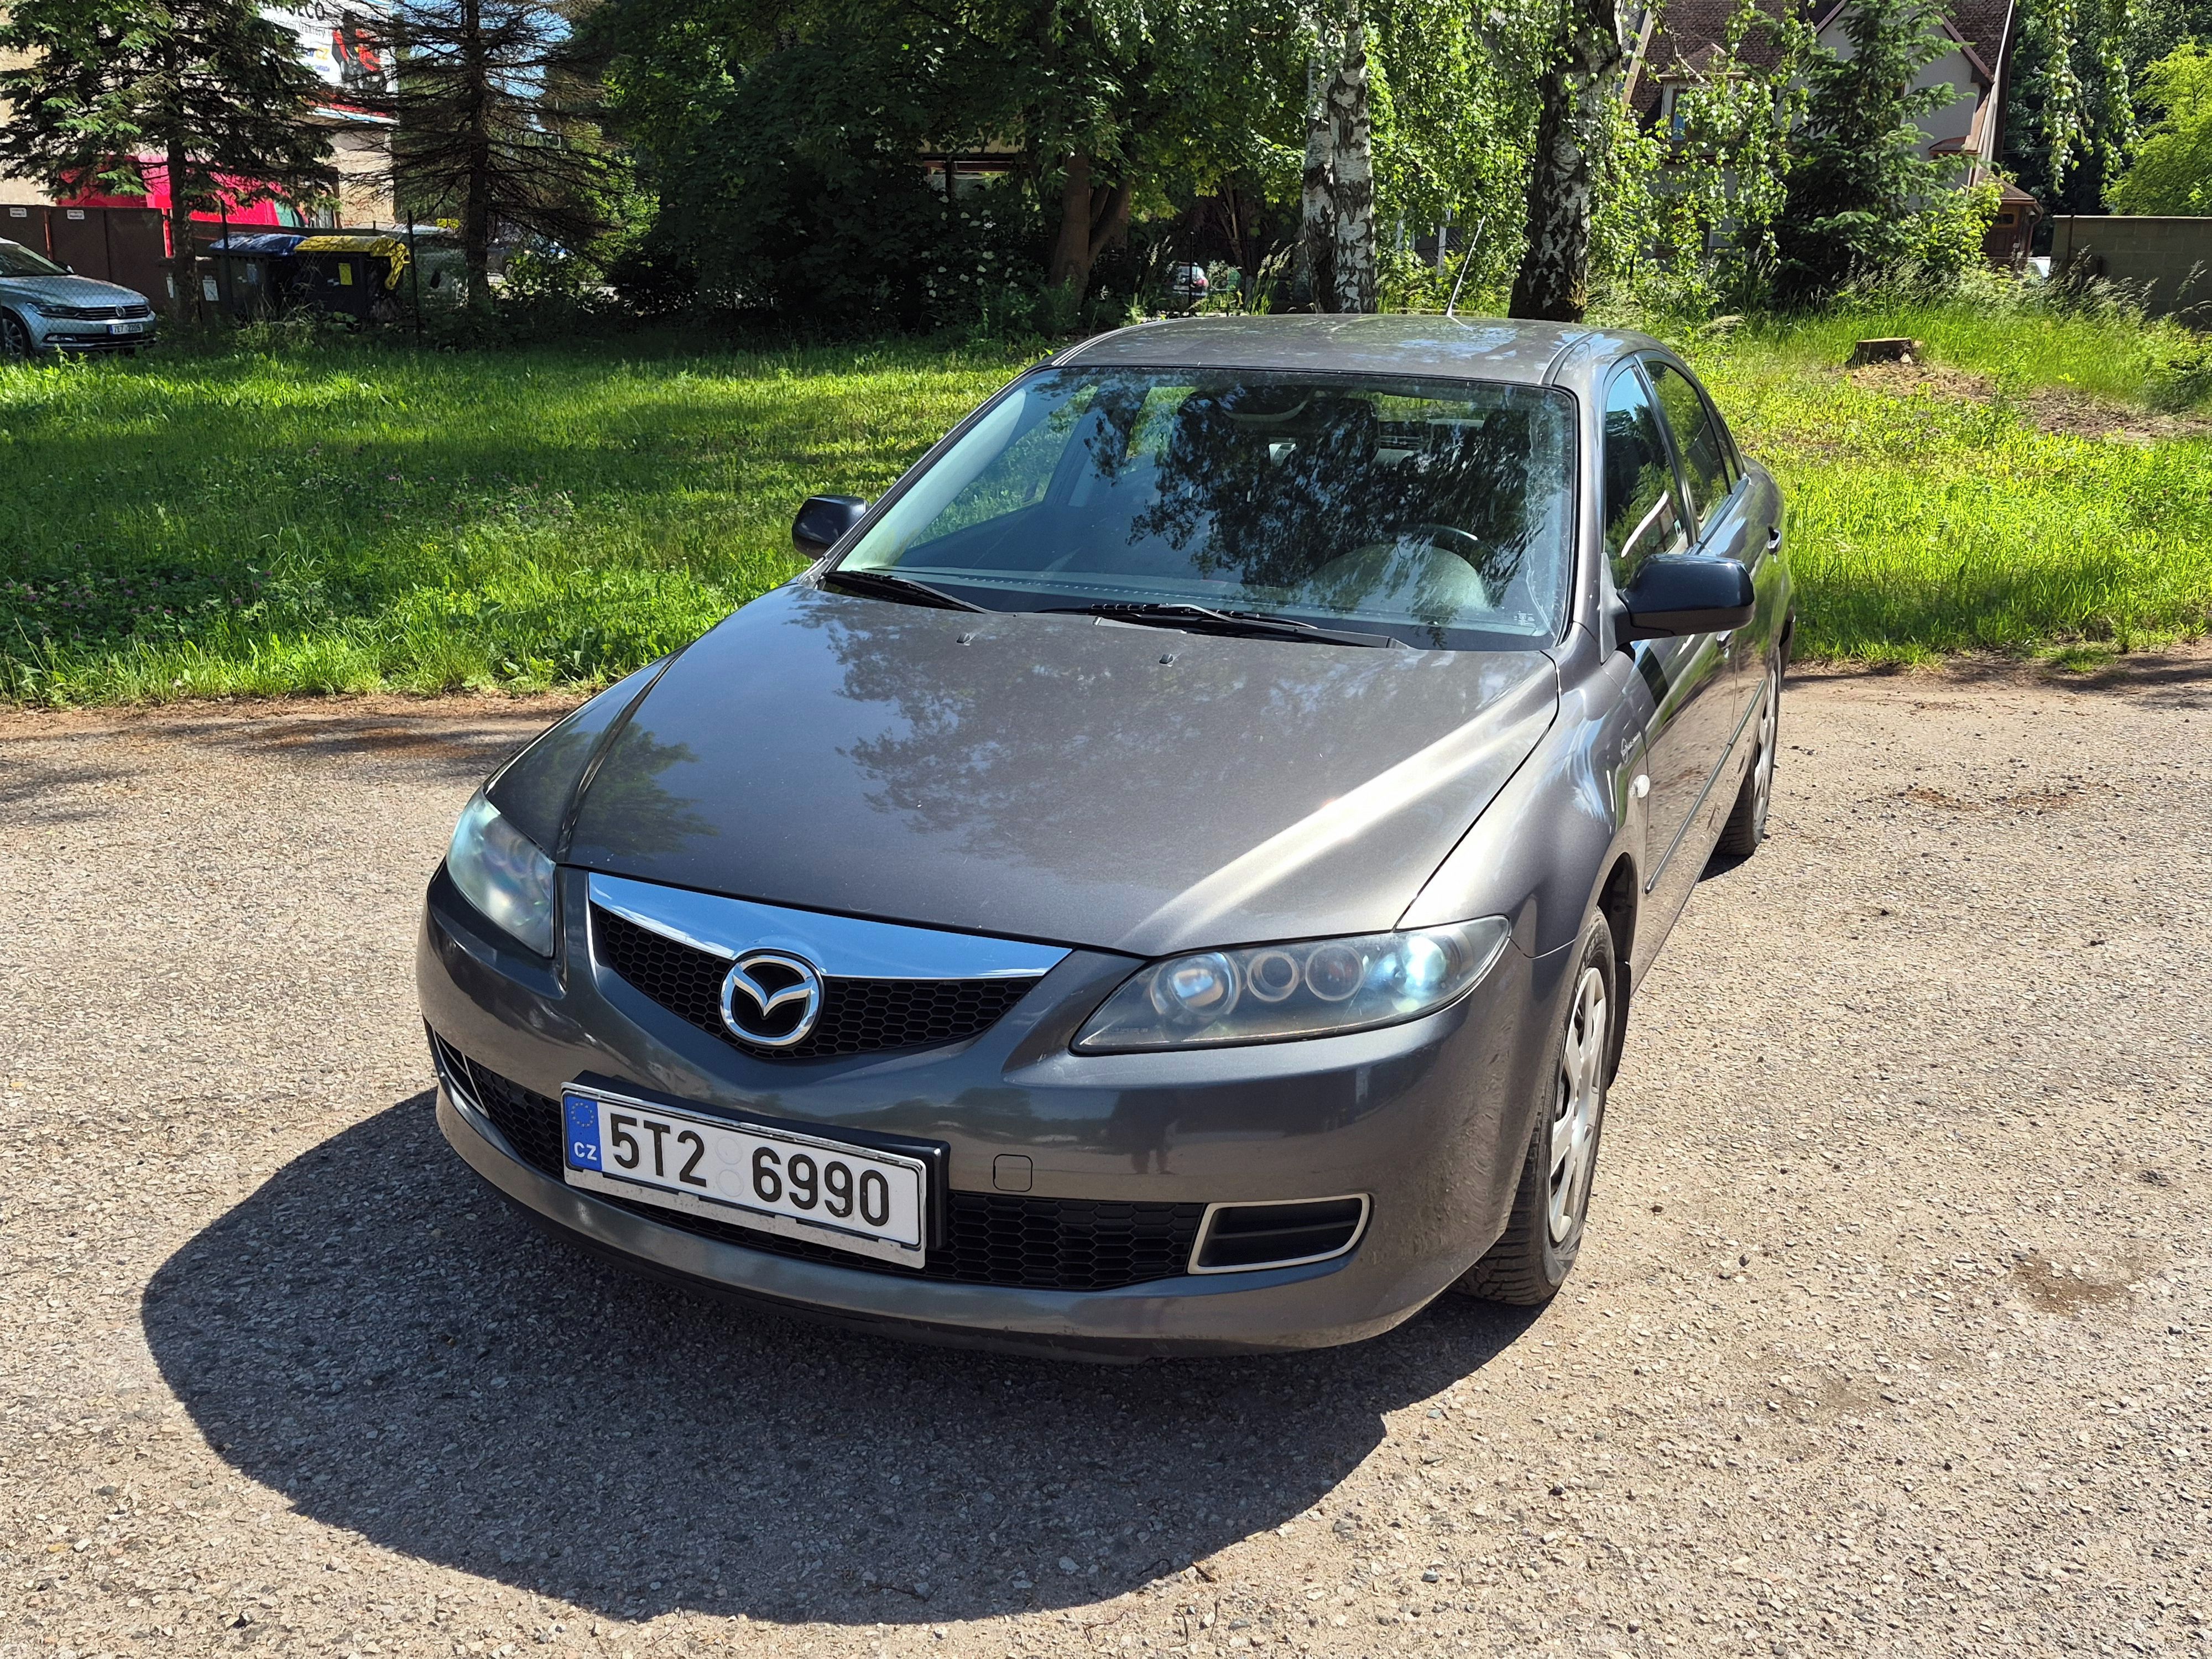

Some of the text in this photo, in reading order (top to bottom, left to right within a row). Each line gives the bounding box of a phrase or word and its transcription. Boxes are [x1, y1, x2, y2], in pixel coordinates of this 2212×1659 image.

[574, 1141, 597, 1161] CZ
[609, 1113, 890, 1227] 5T2 6990
